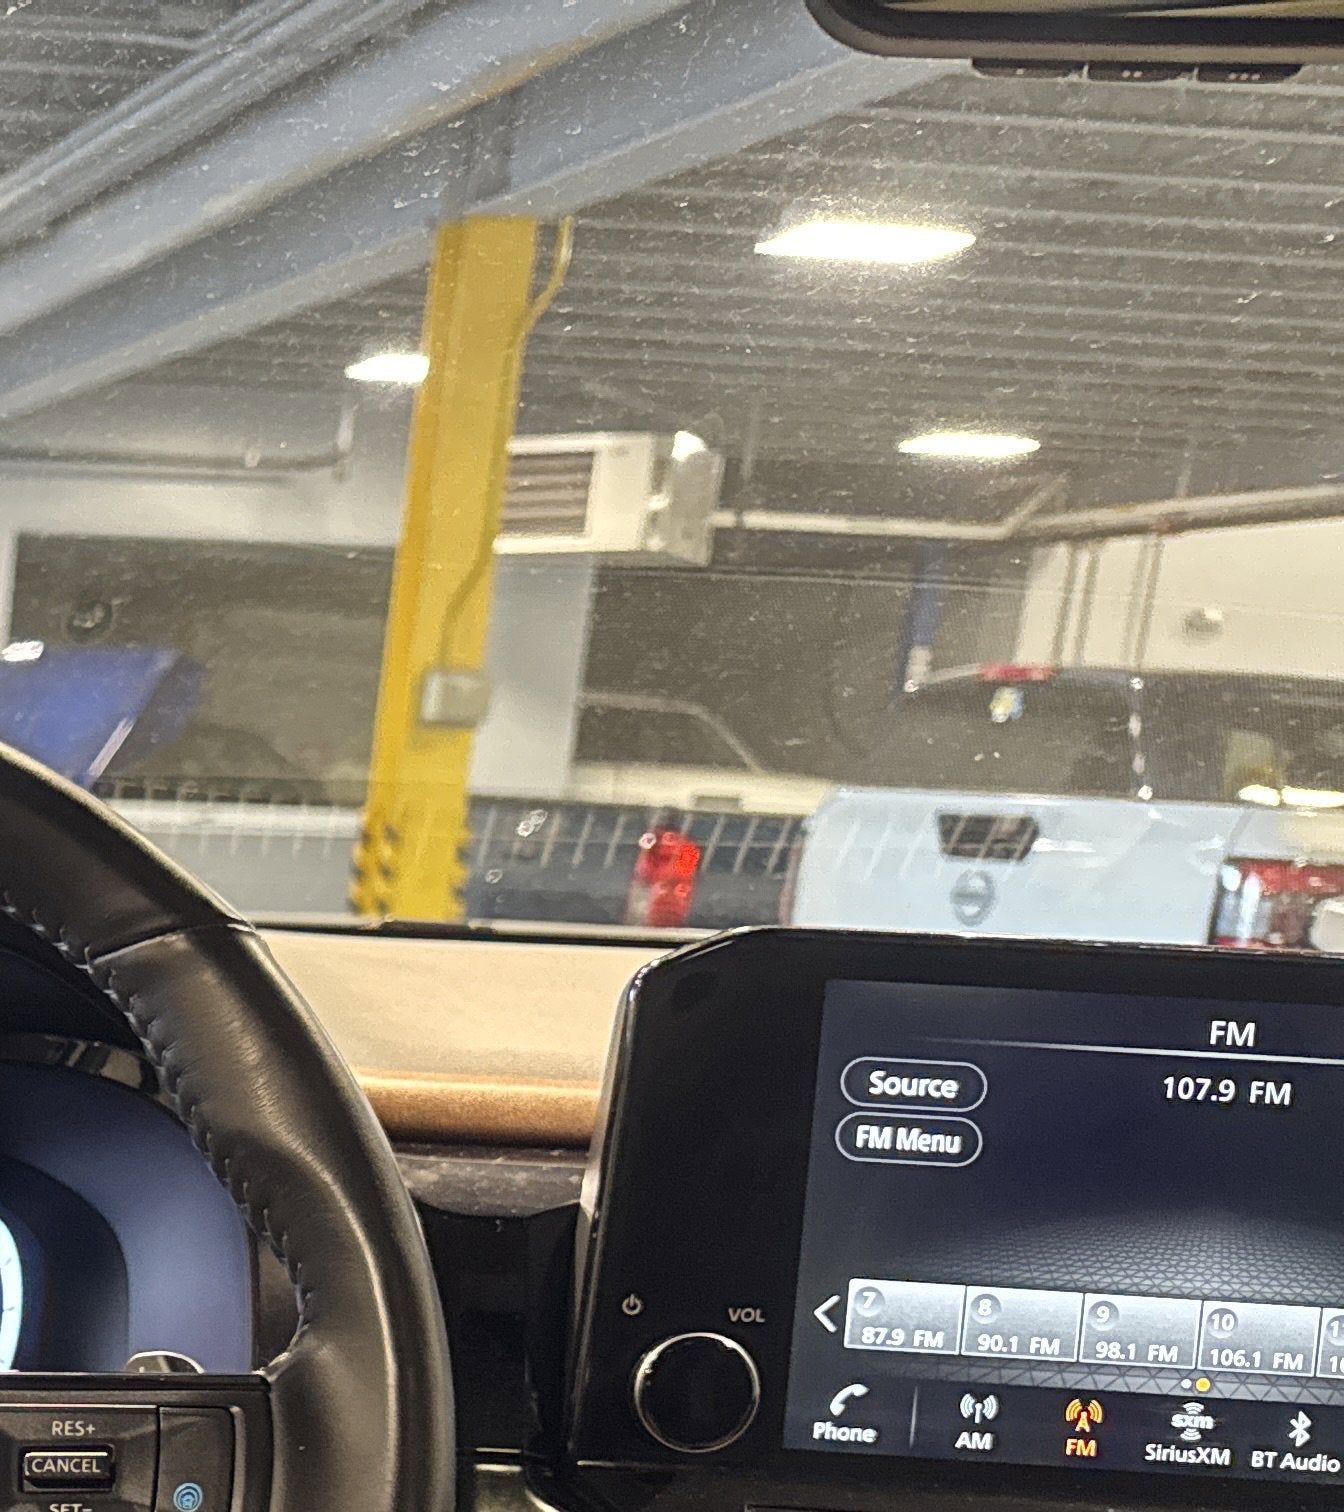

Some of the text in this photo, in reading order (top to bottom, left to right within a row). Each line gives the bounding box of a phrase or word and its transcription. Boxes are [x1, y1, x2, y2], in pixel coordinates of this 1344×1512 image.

[1209, 1020, 1256, 1047] FM
[868, 1070, 960, 1099] Source
[1163, 1076, 1292, 1106] 107.9 FM
[855, 1125, 962, 1154] FM Menu
[861, 1290, 876, 1309] 7
[977, 1298, 992, 1318] 8
[728, 1308, 765, 1323] VOL
[1096, 1305, 1110, 1324] 9
[1211, 1312, 1236, 1333] 10
[861, 1327, 945, 1349] 87.9 FM
[976, 1334, 1061, 1356] 90.1 FM
[1095, 1342, 1179, 1364] 98.1 FM
[1210, 1349, 1304, 1371] 106.1 FM
[812, 1421, 877, 1444] Phone
[1171, 1413, 1215, 1431] sxm
[954, 1430, 994, 1451] AM
[1065, 1438, 1098, 1458] FM
[31, 1458, 101, 1473] CANCEL
[1144, 1442, 1232, 1467] SiriusXM
[1250, 1450, 1342, 1474] BT Audio
